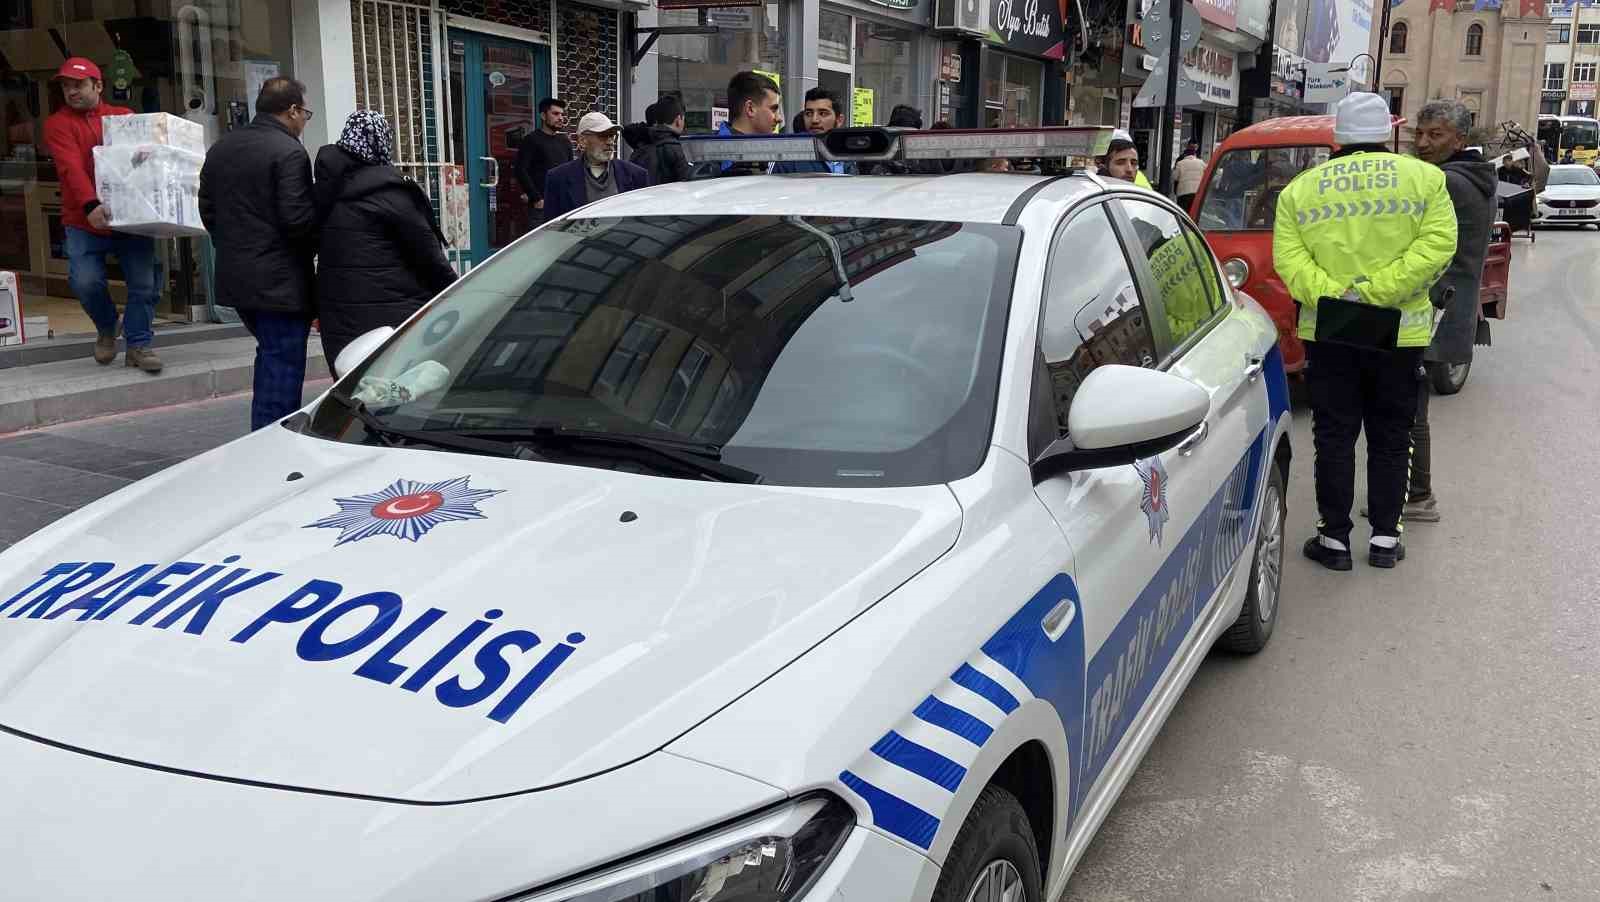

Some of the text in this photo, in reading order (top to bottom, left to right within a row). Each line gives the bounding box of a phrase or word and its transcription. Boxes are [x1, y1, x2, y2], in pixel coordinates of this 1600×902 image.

[1320, 160, 1397, 177] TRAFİK
[1318, 172, 1398, 195] POLİSİ
[0, 554, 586, 725] TRAFİK POLİSİ
